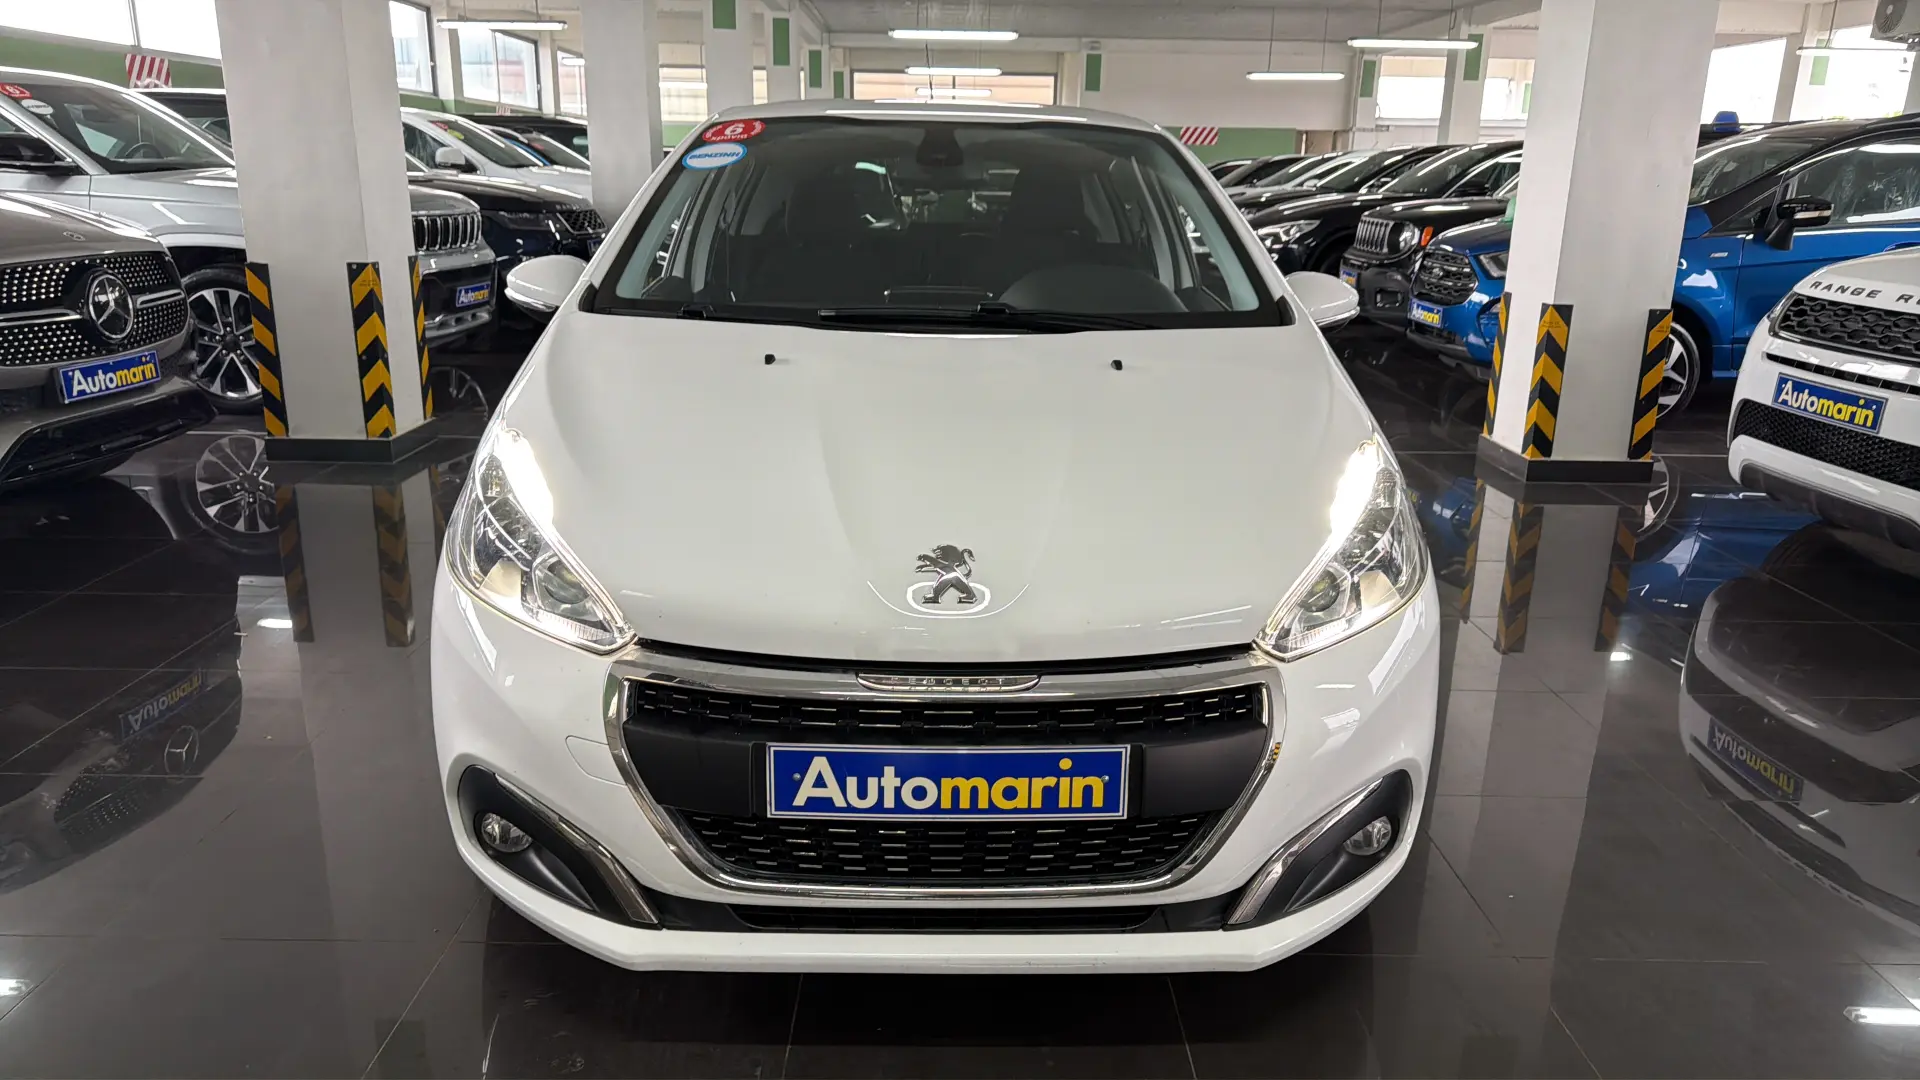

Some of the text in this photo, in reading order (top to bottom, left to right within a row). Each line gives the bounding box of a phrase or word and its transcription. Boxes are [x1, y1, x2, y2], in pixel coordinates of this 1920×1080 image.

[724, 122, 745, 136] 6
[1809, 280, 1883, 299] RANGE
[72, 356, 156, 397] Automarin
[1777, 380, 1875, 428] Automarin
[792, 756, 1105, 810] Automarin
